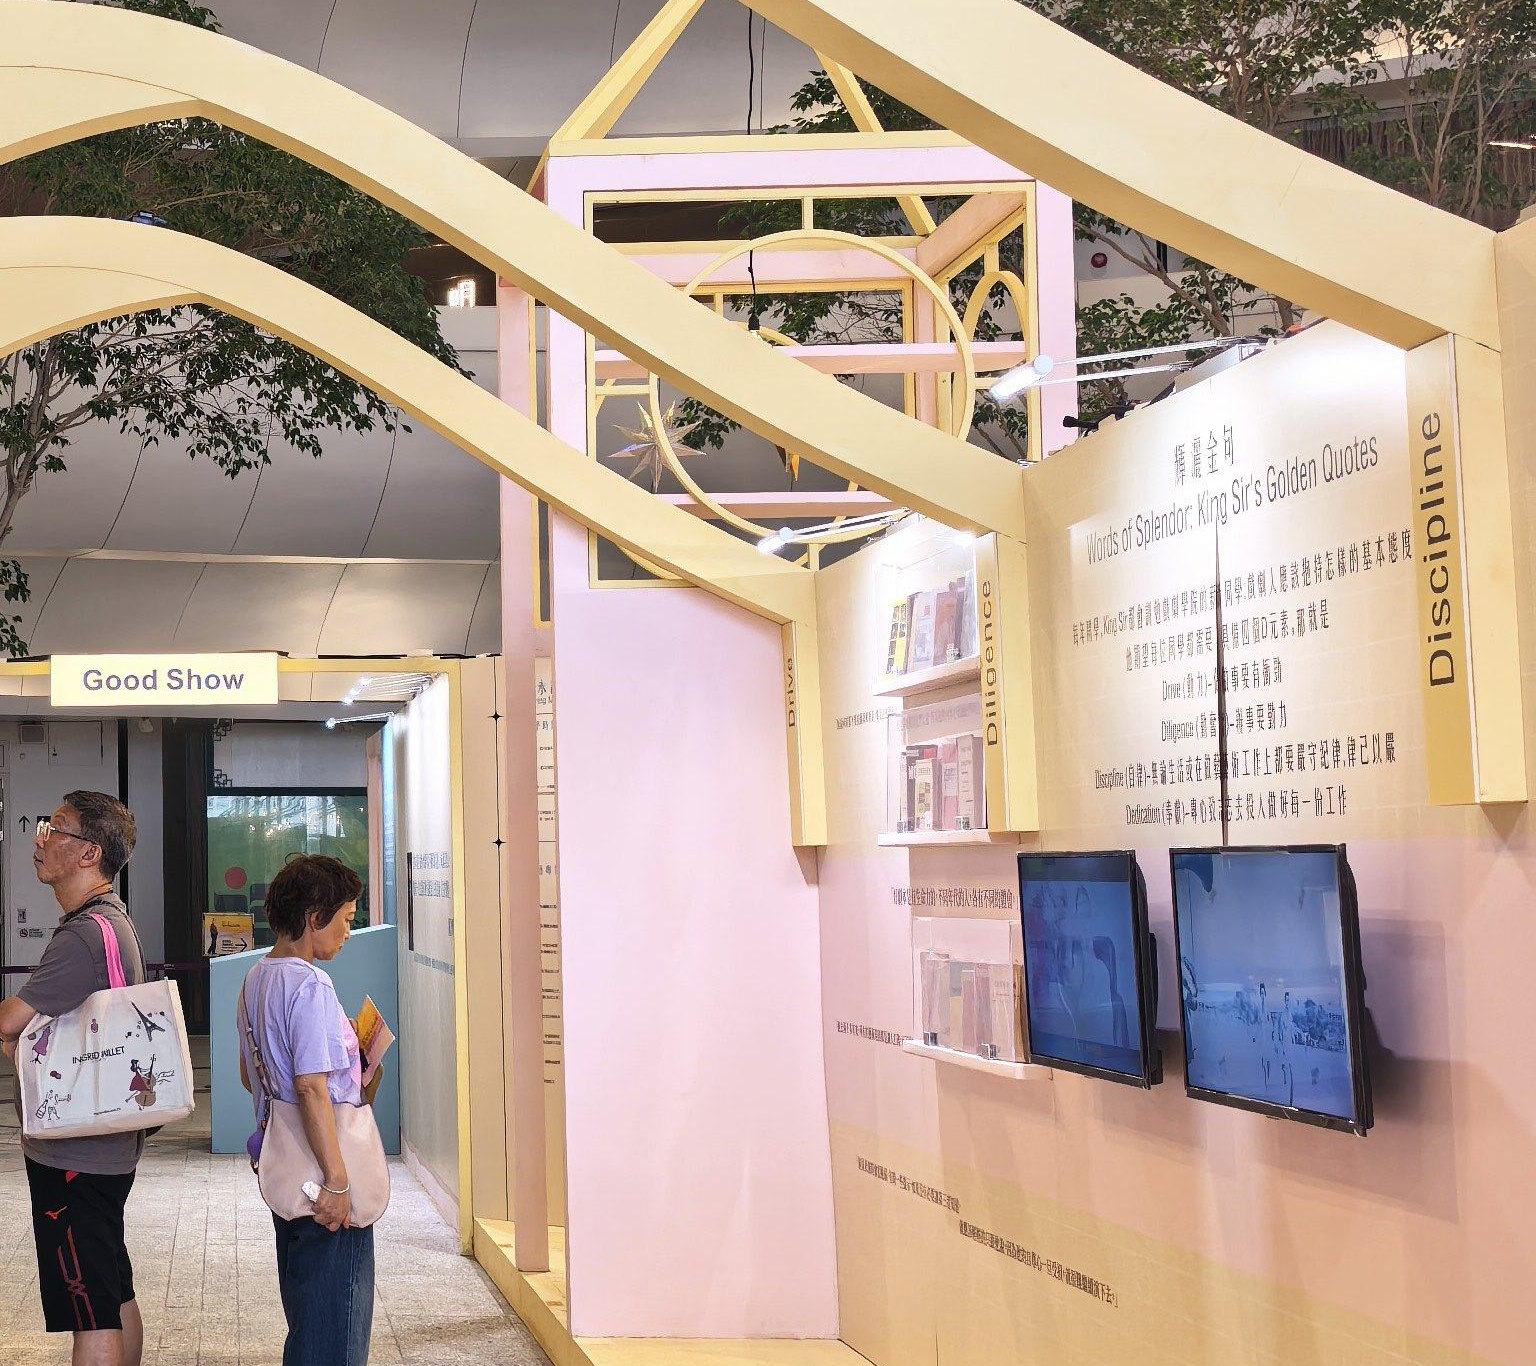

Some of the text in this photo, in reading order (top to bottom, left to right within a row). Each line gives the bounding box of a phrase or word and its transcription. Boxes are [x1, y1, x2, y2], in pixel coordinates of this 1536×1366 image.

[1086, 436, 1378, 566] Words of Splendor: King Sir's Golden Quotes
[1421, 411, 1455, 687] Discipline
[83, 668, 244, 691] Good Show
[786, 656, 797, 729] Drive
[982, 580, 998, 746] Diligence
[72, 1051, 100, 1064] INGRID
